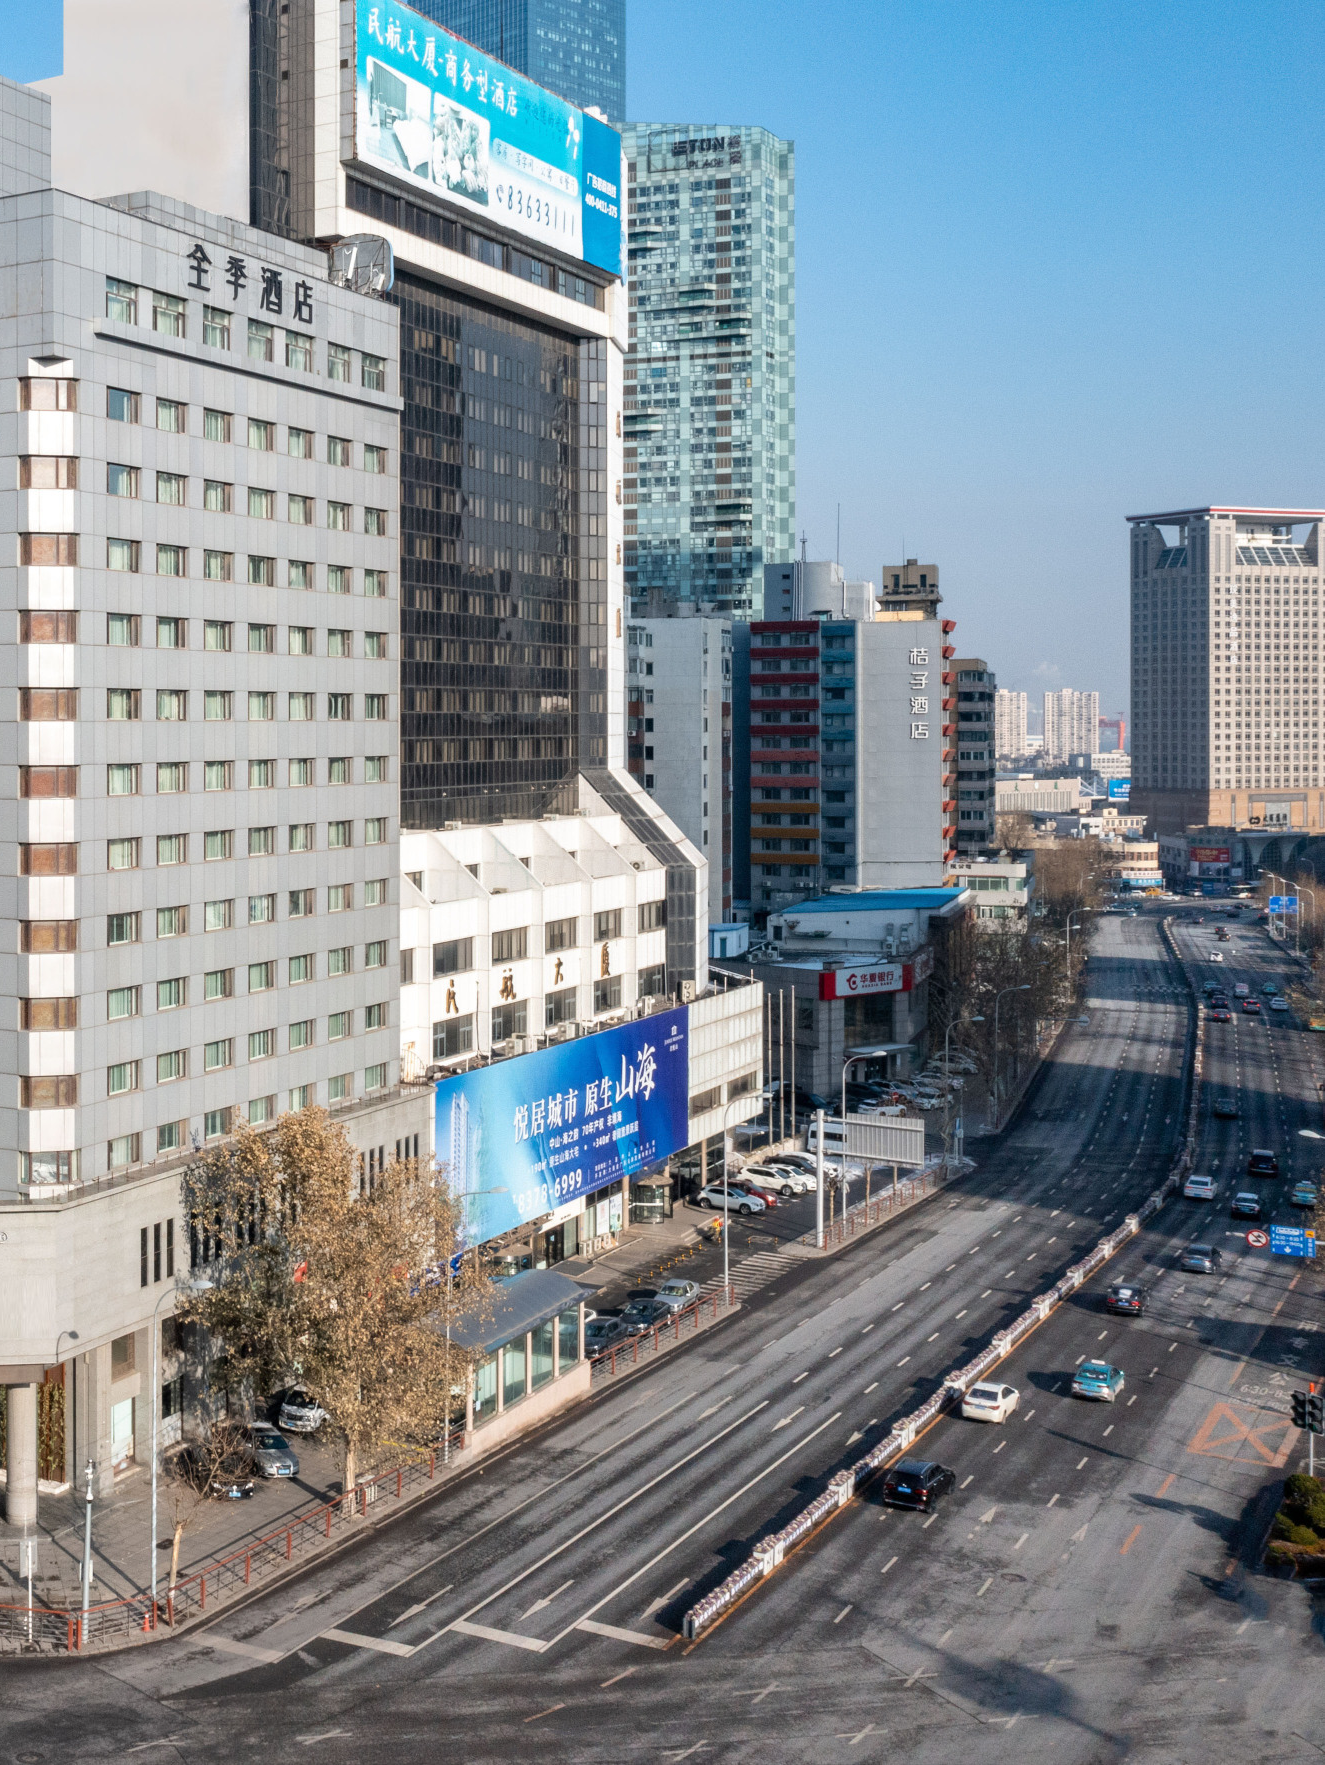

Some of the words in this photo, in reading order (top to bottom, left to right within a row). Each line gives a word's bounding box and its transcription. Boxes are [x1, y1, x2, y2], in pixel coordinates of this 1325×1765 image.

[507, 185, 574, 237] 83633111
[187, 243, 314, 325] 全季酒店
[909, 647, 929, 739] 桔子酒店
[860, 971, 894, 983] 华夏银行
[513, 1088, 579, 1144] 悦居城市
[584, 1042, 658, 1118] 原生山海
